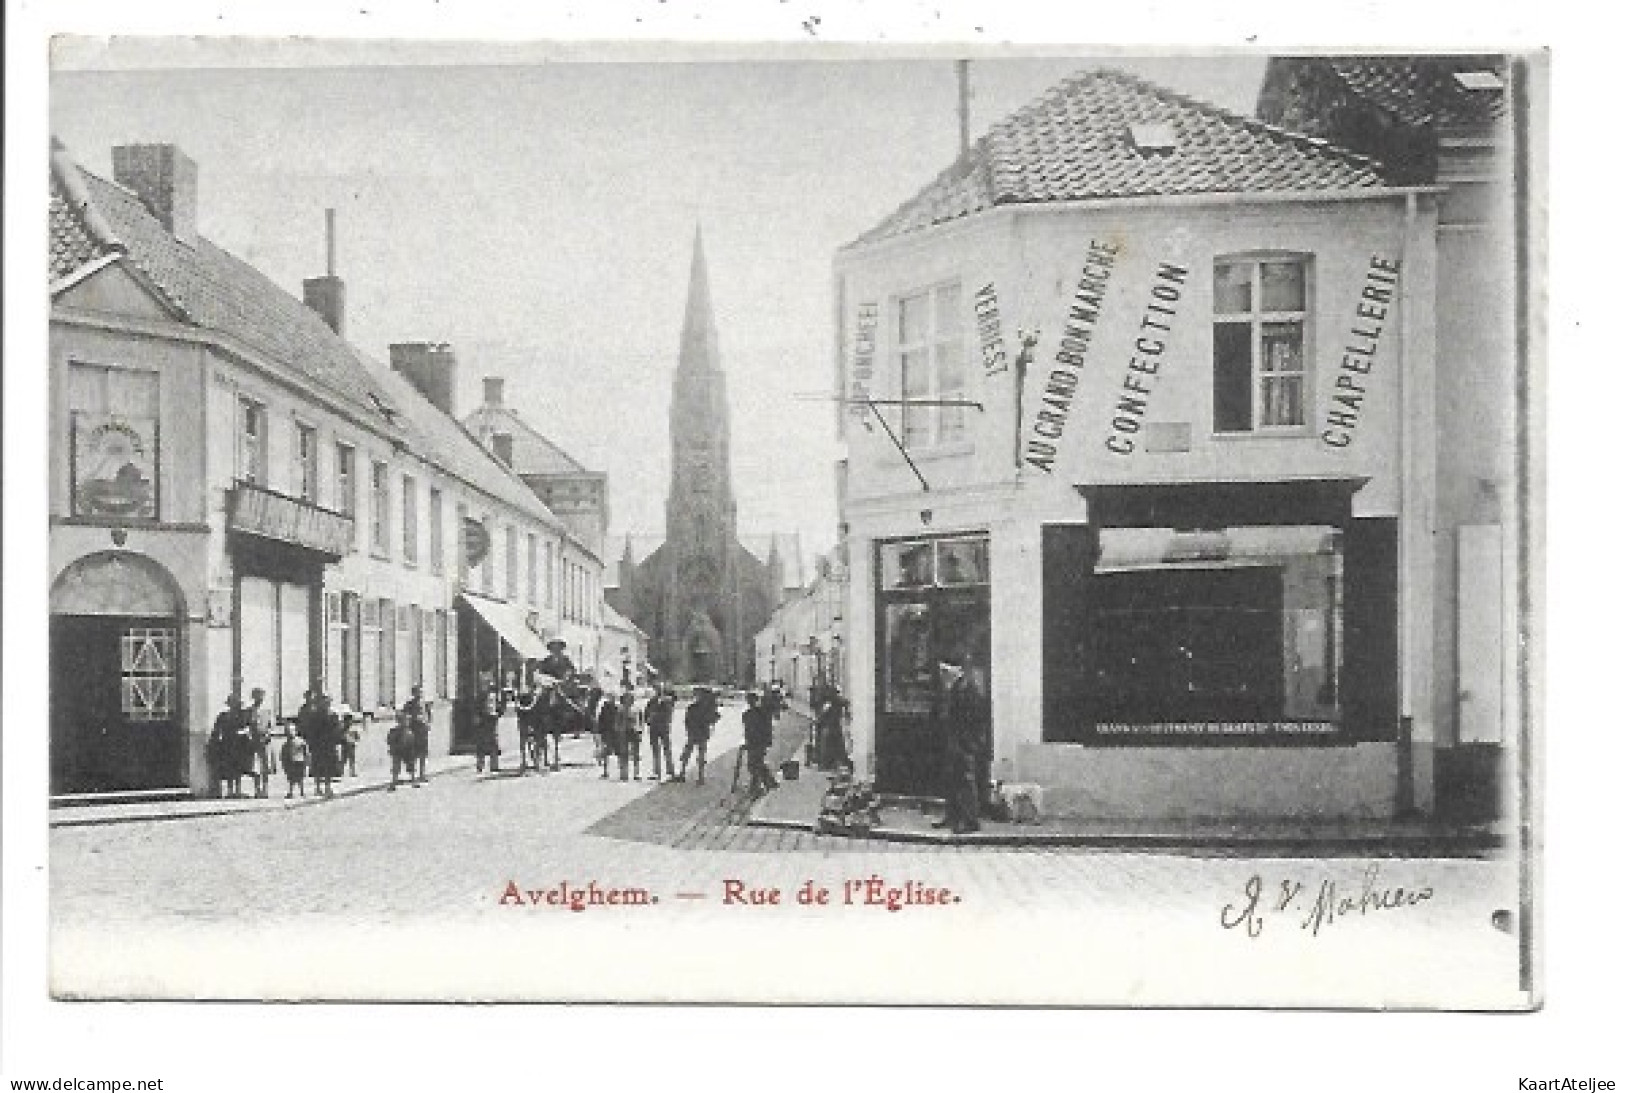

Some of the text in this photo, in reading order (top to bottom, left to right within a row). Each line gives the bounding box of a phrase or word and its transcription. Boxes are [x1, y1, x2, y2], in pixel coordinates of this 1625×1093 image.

[1056, 325, 1091, 369] BON
[1105, 262, 1189, 455] CONFECTION
[1321, 253, 1402, 448] CHAPELLERIE
[1034, 370, 1078, 440] GRAND
[1026, 440, 1058, 474] AU
